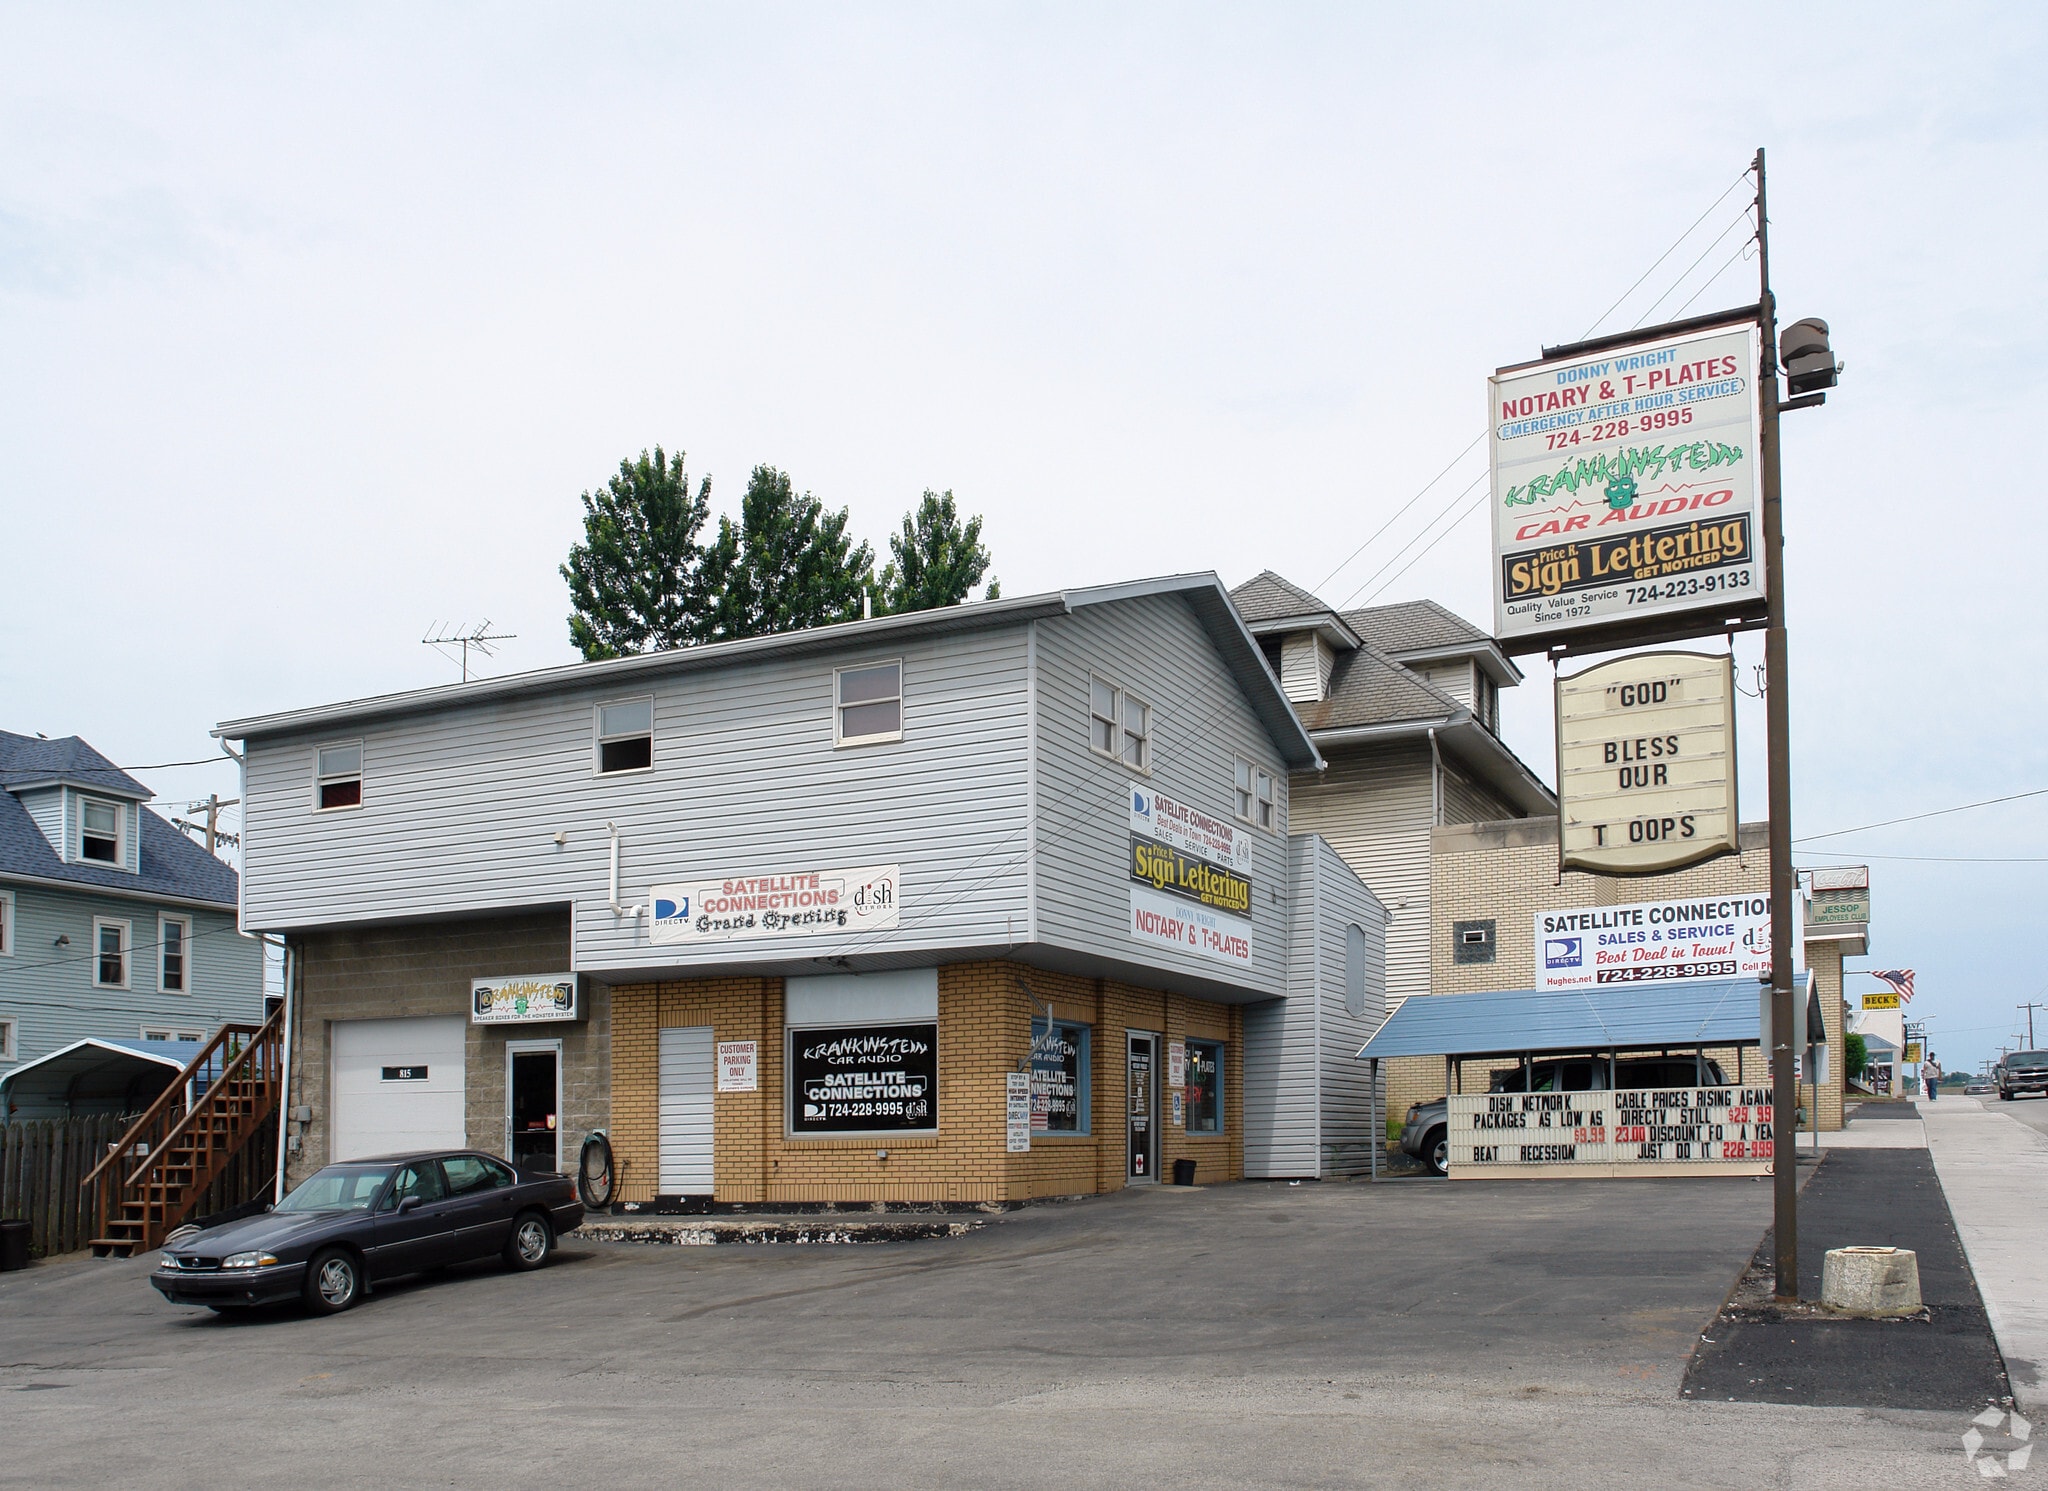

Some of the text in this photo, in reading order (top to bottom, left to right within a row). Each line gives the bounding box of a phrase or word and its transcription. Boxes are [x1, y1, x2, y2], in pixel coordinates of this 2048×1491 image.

[1557, 349, 1677, 385] DONNY WRIGHT
[1502, 355, 1737, 420] NOTARY & T-PLATES
[1502, 380, 1739, 438] EMERGENCY AFTER HOUR SERVICE
[1545, 407, 1693, 450] 724-228-9995
[1504, 439, 1743, 507] KRANKINSTEIN
[1515, 489, 1733, 541] CAR AUDIO
[1511, 521, 1744, 595] Sign Lettering
[1540, 544, 1579, 564] Price R.
[1634, 552, 1721, 580] GET NOTICED
[1626, 570, 1750, 604] 724-223-9133
[1507, 589, 1618, 615] Quality Value Service
[1534, 605, 1591, 622] Since 1972
[1606, 679, 1681, 707] "GOD"
[1604, 735, 1679, 764] BLESS
[1619, 763, 1667, 788] OUR
[1154, 794, 1233, 843] SATELLITE CONNECTIONS
[1157, 814, 1168, 827] Best
[1152, 844, 1168, 857] Price
[1154, 827, 1173, 842] SALES
[1184, 839, 1208, 856] SERVICE
[1217, 852, 1233, 867] PARTS
[722, 873, 820, 895] SATELLITE
[1135, 845, 1248, 910] Sign Lettering
[704, 888, 839, 914] CONNECTIONS
[853, 884, 893, 906] dish
[1201, 893, 1240, 909] GET NOTICED
[1175, 906, 1216, 928] DONNY WRIGHT
[1815, 912, 1867, 922] EMPLOYEES CLUB
[1823, 904, 1859, 914] JESSOP
[655, 918, 690, 926] DIRECTV
[696, 907, 848, 933] Grand Opening
[1543, 908, 1644, 933] SATELLITE
[1136, 909, 1249, 959] NOTARY & T-PLATES
[1598, 923, 1735, 946] SALES & SERVICE
[1595, 941, 1735, 965] Best Deal in Town!
[1599, 962, 1735, 983] 724-228-9995
[1742, 962, 1758, 971] Cell
[1547, 974, 1592, 987] Hughes.net
[1864, 995, 1898, 1004] BECK'S
[720, 1043, 754, 1054] CUSTOMER
[803, 1036, 928, 1059] KRANKINSTEIN
[723, 1055, 751, 1065] PARKING
[828, 1054, 902, 1065] CAR AUDIO
[399, 1069, 411, 1078] 815
[729, 1067, 745, 1077] ONLY
[825, 1071, 906, 1086] SATELLITE
[1031, 1069, 1066, 1083] ATELLITE
[809, 1084, 922, 1100] CONNECTIONS
[1615, 1089, 1773, 1109] CABLE PRICES RISING AGAIN
[829, 1102, 903, 1117] 724-228-9995
[1489, 1095, 1571, 1112] DISH NETWORK
[1474, 1110, 1603, 1129] PACKAGES AS LOW AS
[1621, 1108, 1666, 1126] DIRECTV
[1680, 1108, 1711, 1124] STILL
[1574, 1126, 1605, 1144] $9.99
[1615, 1126, 1645, 1143] 23.00
[1651, 1125, 1701, 1142] DISCOUNT
[1740, 1124, 1747, 1140] A
[1473, 1145, 1576, 1161] BEAT RECESSION
[1637, 1142, 1664, 1159] JUST
[1676, 1142, 1690, 1158] DO
[1701, 1142, 1711, 1158] IT
